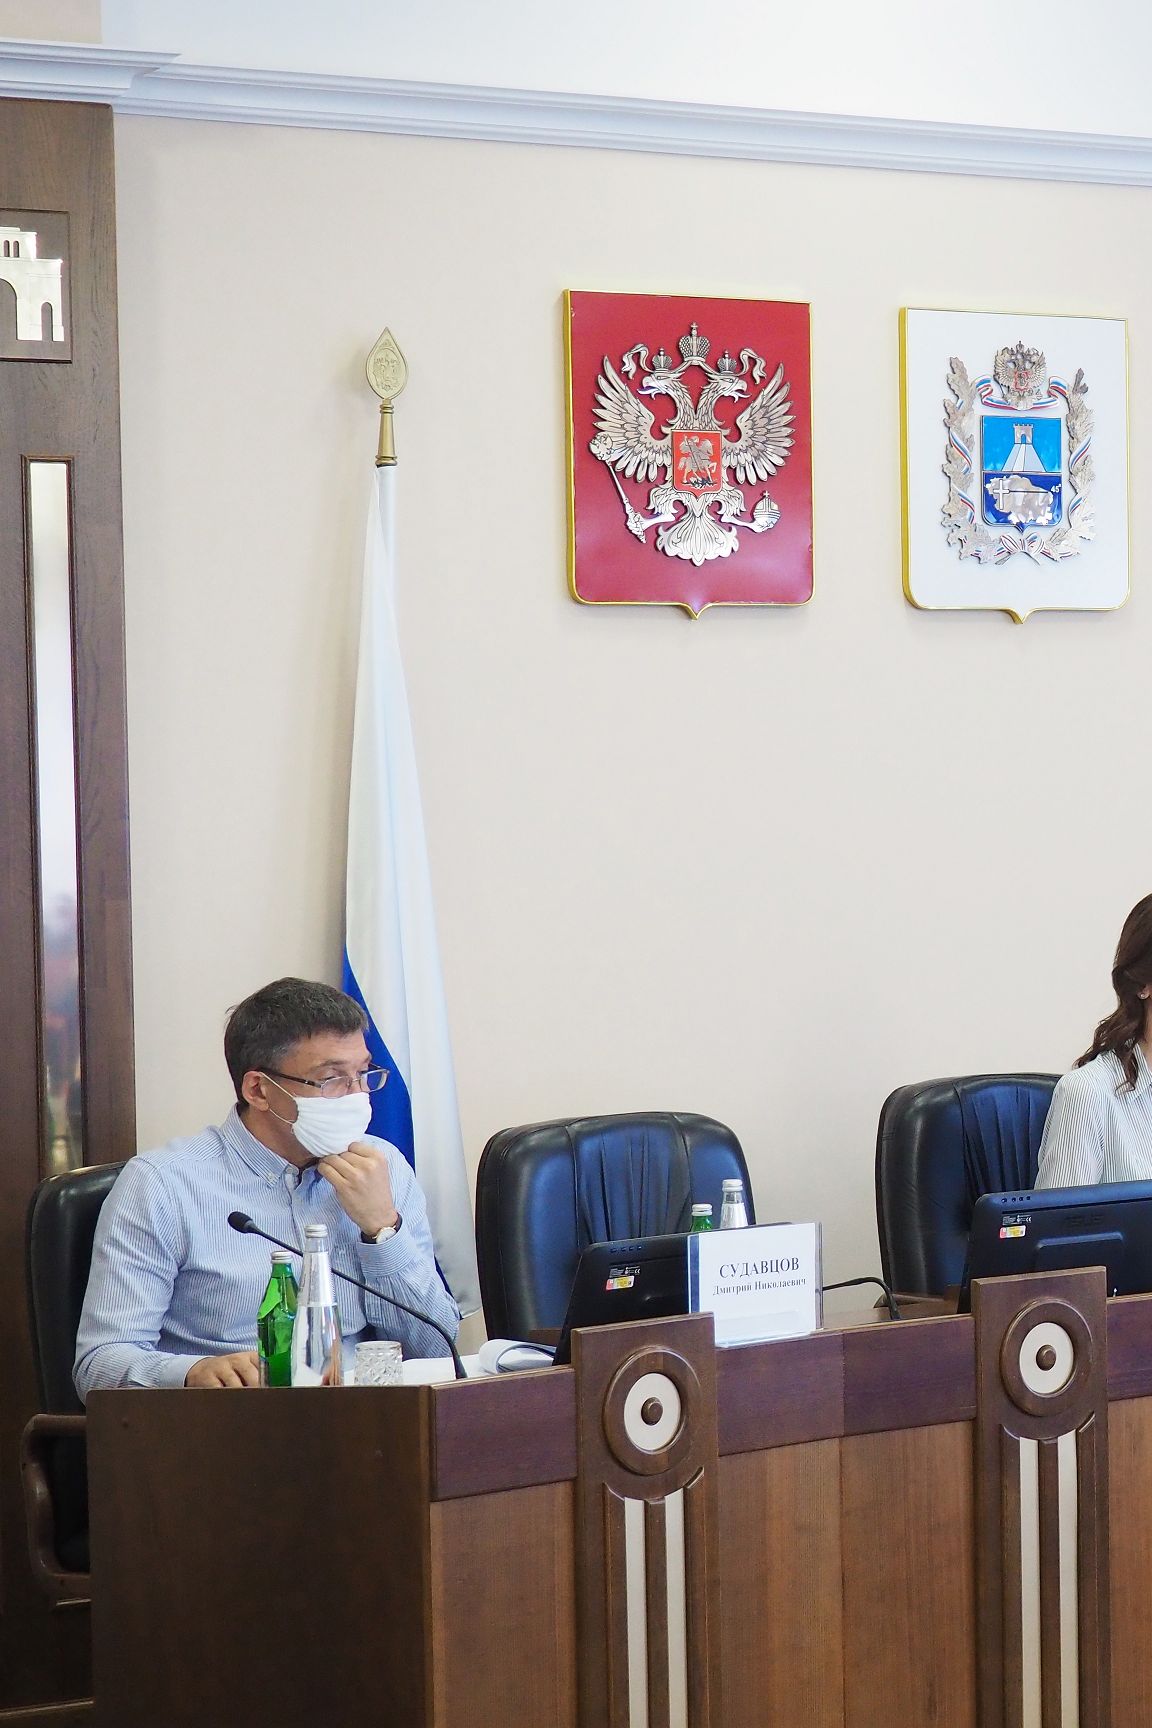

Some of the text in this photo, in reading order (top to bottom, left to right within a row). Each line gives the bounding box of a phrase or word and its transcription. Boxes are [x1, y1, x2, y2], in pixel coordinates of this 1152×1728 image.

[719, 1257, 800, 1278] СУДАВЦОВ
[712, 1278, 806, 1296] Дмитрий Николаевич
